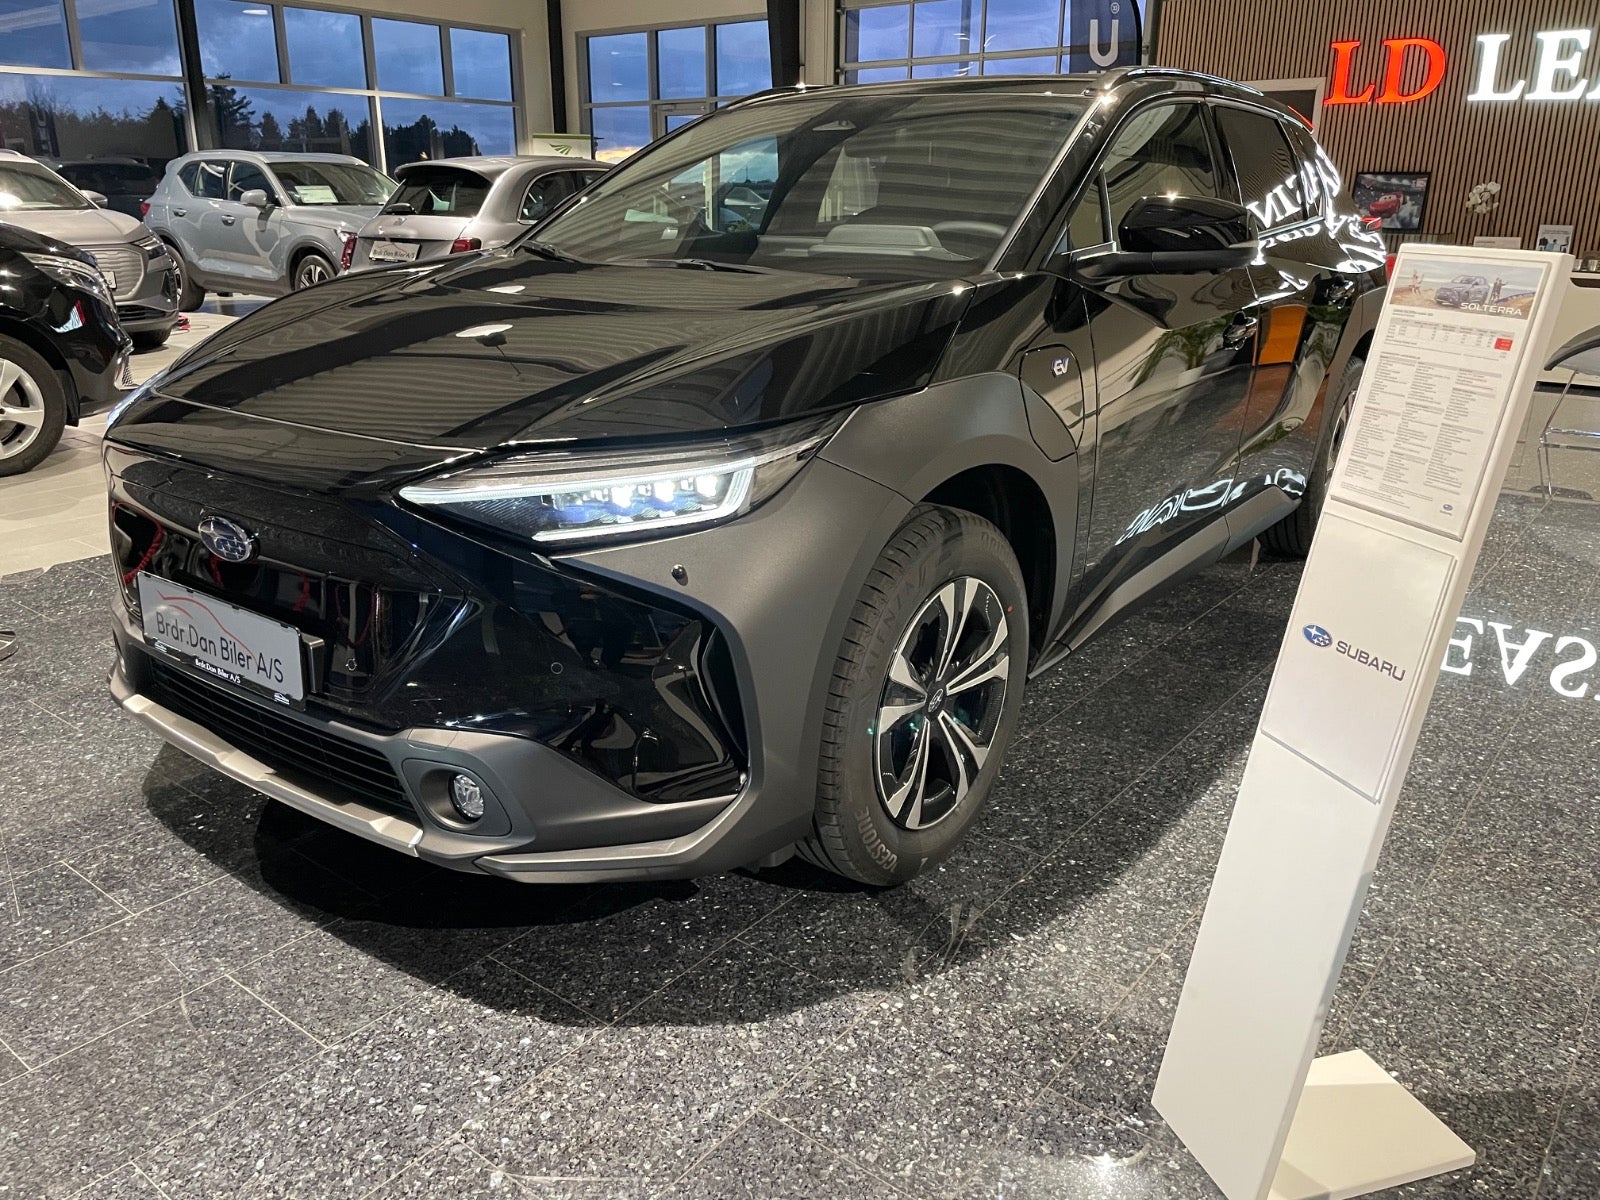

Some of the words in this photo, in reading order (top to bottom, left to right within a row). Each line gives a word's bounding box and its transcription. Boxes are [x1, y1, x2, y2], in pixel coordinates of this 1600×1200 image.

[1323, 37, 1446, 105] LD
[1467, 28, 1600, 102] LE
[1460, 302, 1522, 316] SOLTERRA
[1053, 357, 1070, 376] EV
[219, 636, 252, 670] Biler
[256, 652, 284, 684] A/S
[1335, 640, 1406, 682] SUBARU
